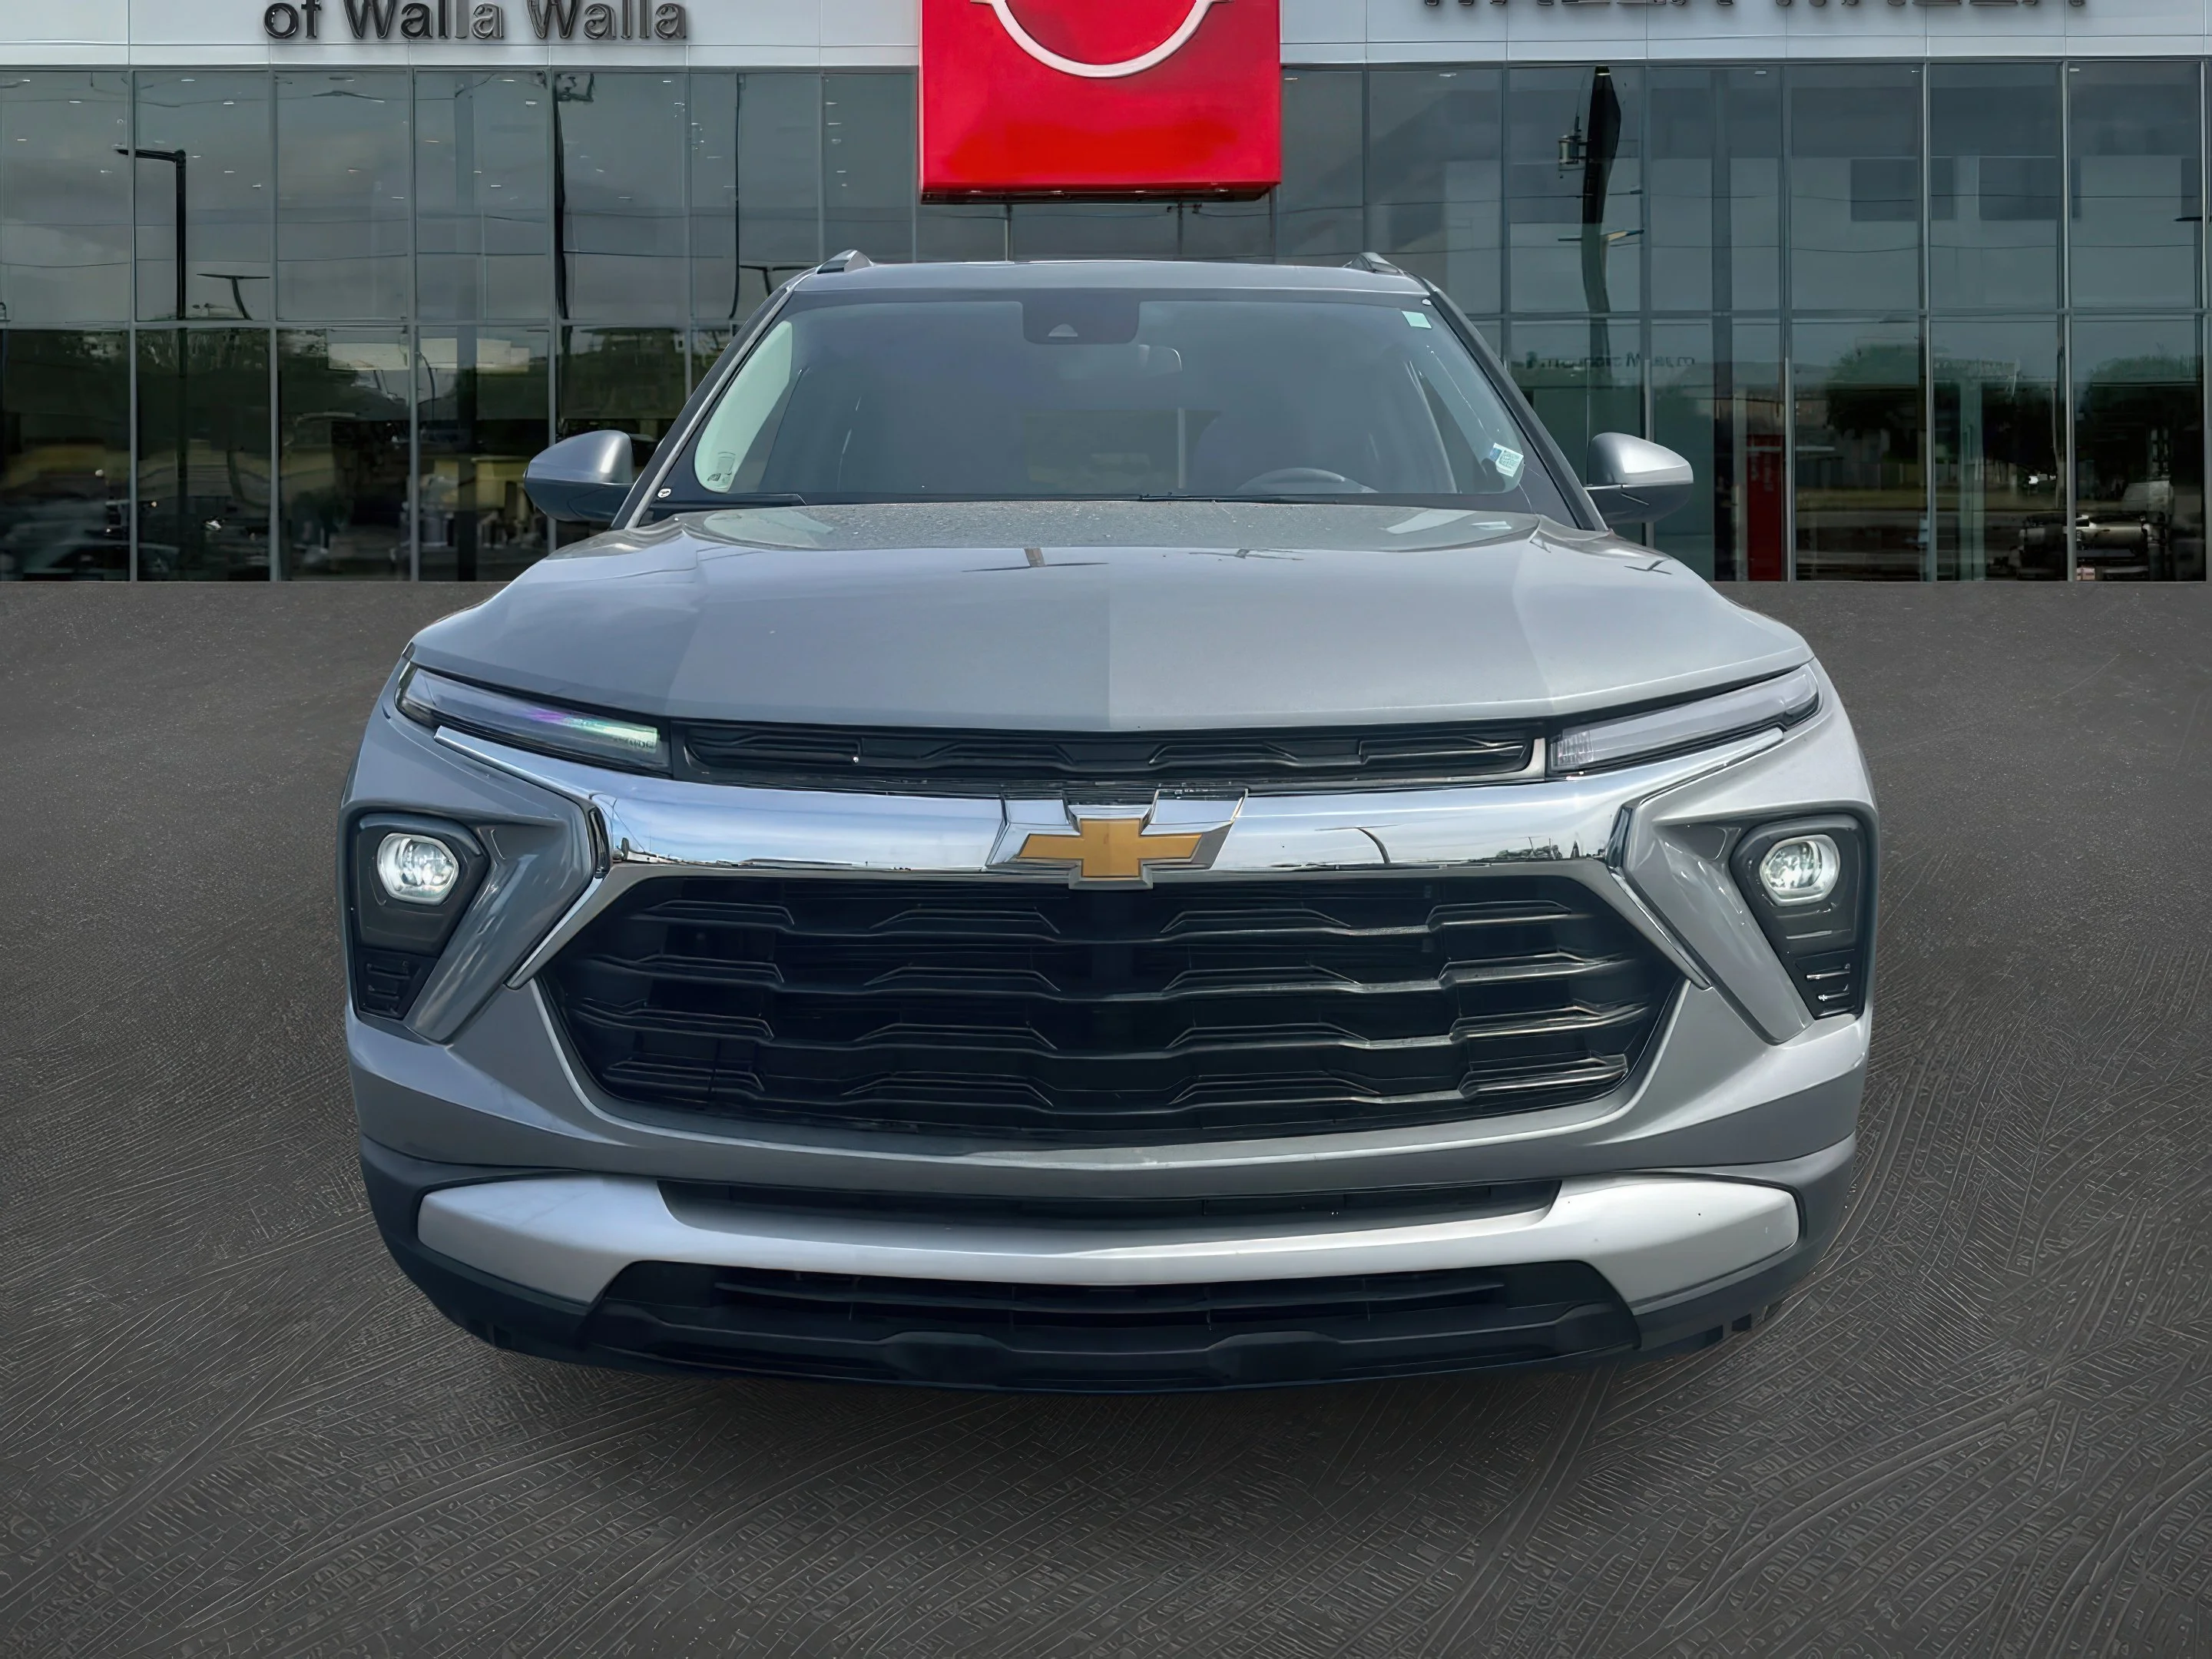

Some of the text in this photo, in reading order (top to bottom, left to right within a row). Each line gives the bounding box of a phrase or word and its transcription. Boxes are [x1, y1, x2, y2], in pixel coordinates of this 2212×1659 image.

[264, 0, 687, 38] of Walla Walla
